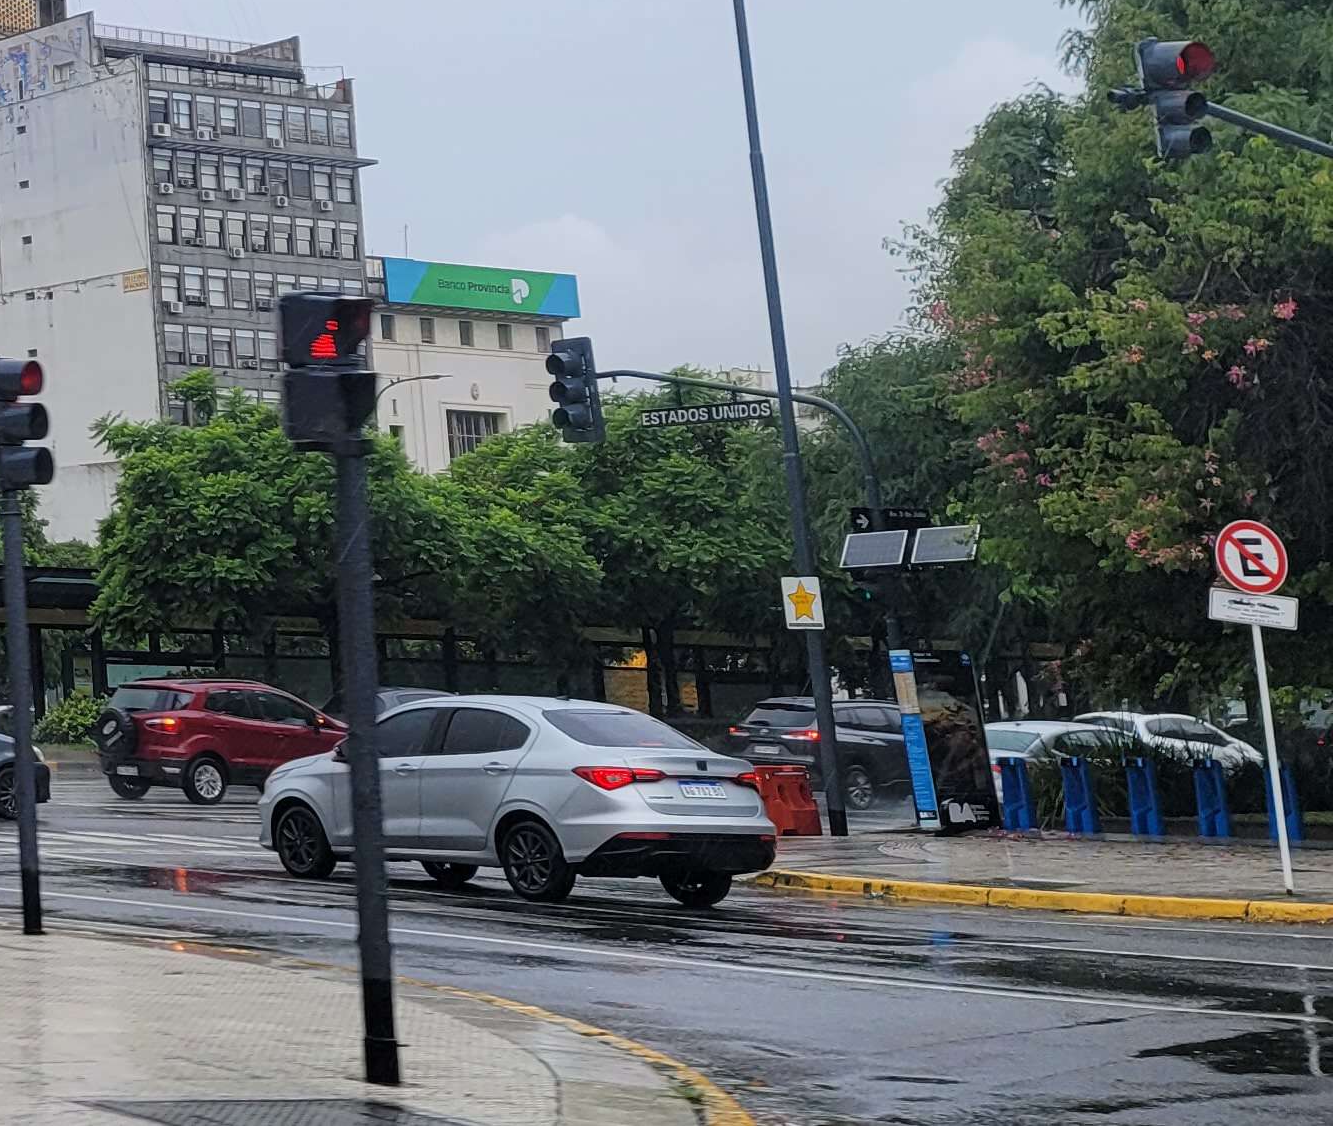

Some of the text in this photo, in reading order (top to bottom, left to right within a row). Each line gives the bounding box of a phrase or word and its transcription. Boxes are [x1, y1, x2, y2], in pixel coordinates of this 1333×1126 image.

[437, 279, 510, 293] Banco Provincia
[641, 402, 771, 426] ESTADOS UNIDOS
